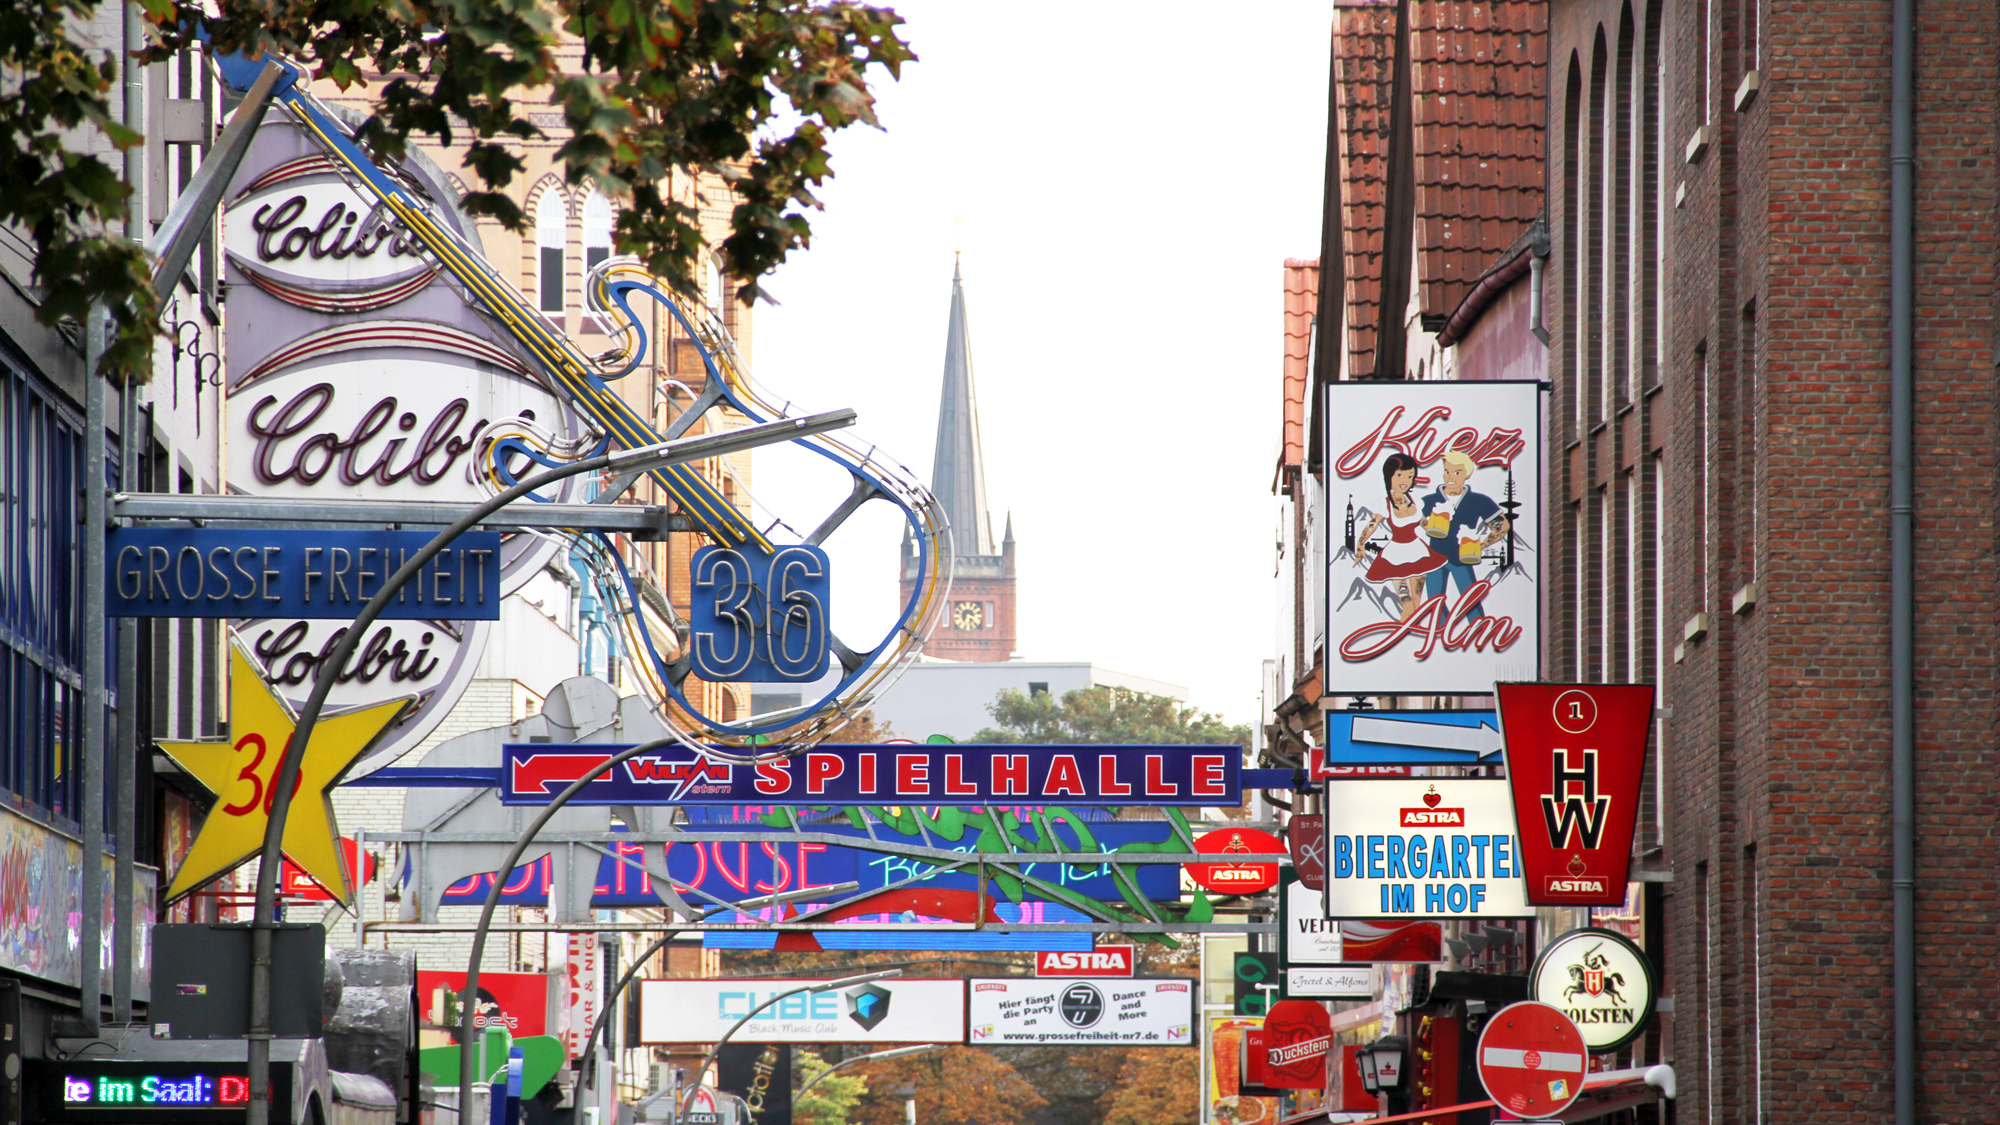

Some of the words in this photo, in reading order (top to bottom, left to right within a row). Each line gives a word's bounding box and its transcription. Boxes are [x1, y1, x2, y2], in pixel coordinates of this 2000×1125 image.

[1335, 405, 1526, 484] Kiez
[116, 546, 281, 600] GROSSE
[695, 548, 825, 677] 36
[1339, 580, 1522, 662] Alm
[754, 753, 1226, 795] SPIELHALLE
[691, 784, 732, 794] stern
[1403, 812, 1461, 823] ASTRA
[1213, 870, 1260, 880] ASTRA
[1550, 881, 1603, 892] ASTRA
[1380, 884, 1415, 913] IM
[1425, 883, 1487, 913] HOF
[1043, 953, 1126, 969] ASTRA
[998, 1000, 1022, 1010] Hier
[1025, 994, 1055, 1005] fängt
[1113, 990, 1146, 1001] Dance
[719, 992, 838, 1020] CUBE
[1003, 1010, 1021, 1019] die
[1023, 1005, 1054, 1016] Party
[1121, 1000, 1141, 1010] and
[584, 1000, 595, 1039] BAR
[1023, 1018, 1037, 1026] an
[1118, 1011, 1147, 1021] More
[749, 1023, 778, 1034] Black
[781, 1022, 812, 1034] Music
[815, 1022, 838, 1034] Club
[1003, 1031, 1160, 1042] www.grossefreiheit-nr7.de
[1268, 1040, 1329, 1066] Duckstein
[100, 1078, 133, 1102] im
[141, 1074, 212, 1102] Saal:
